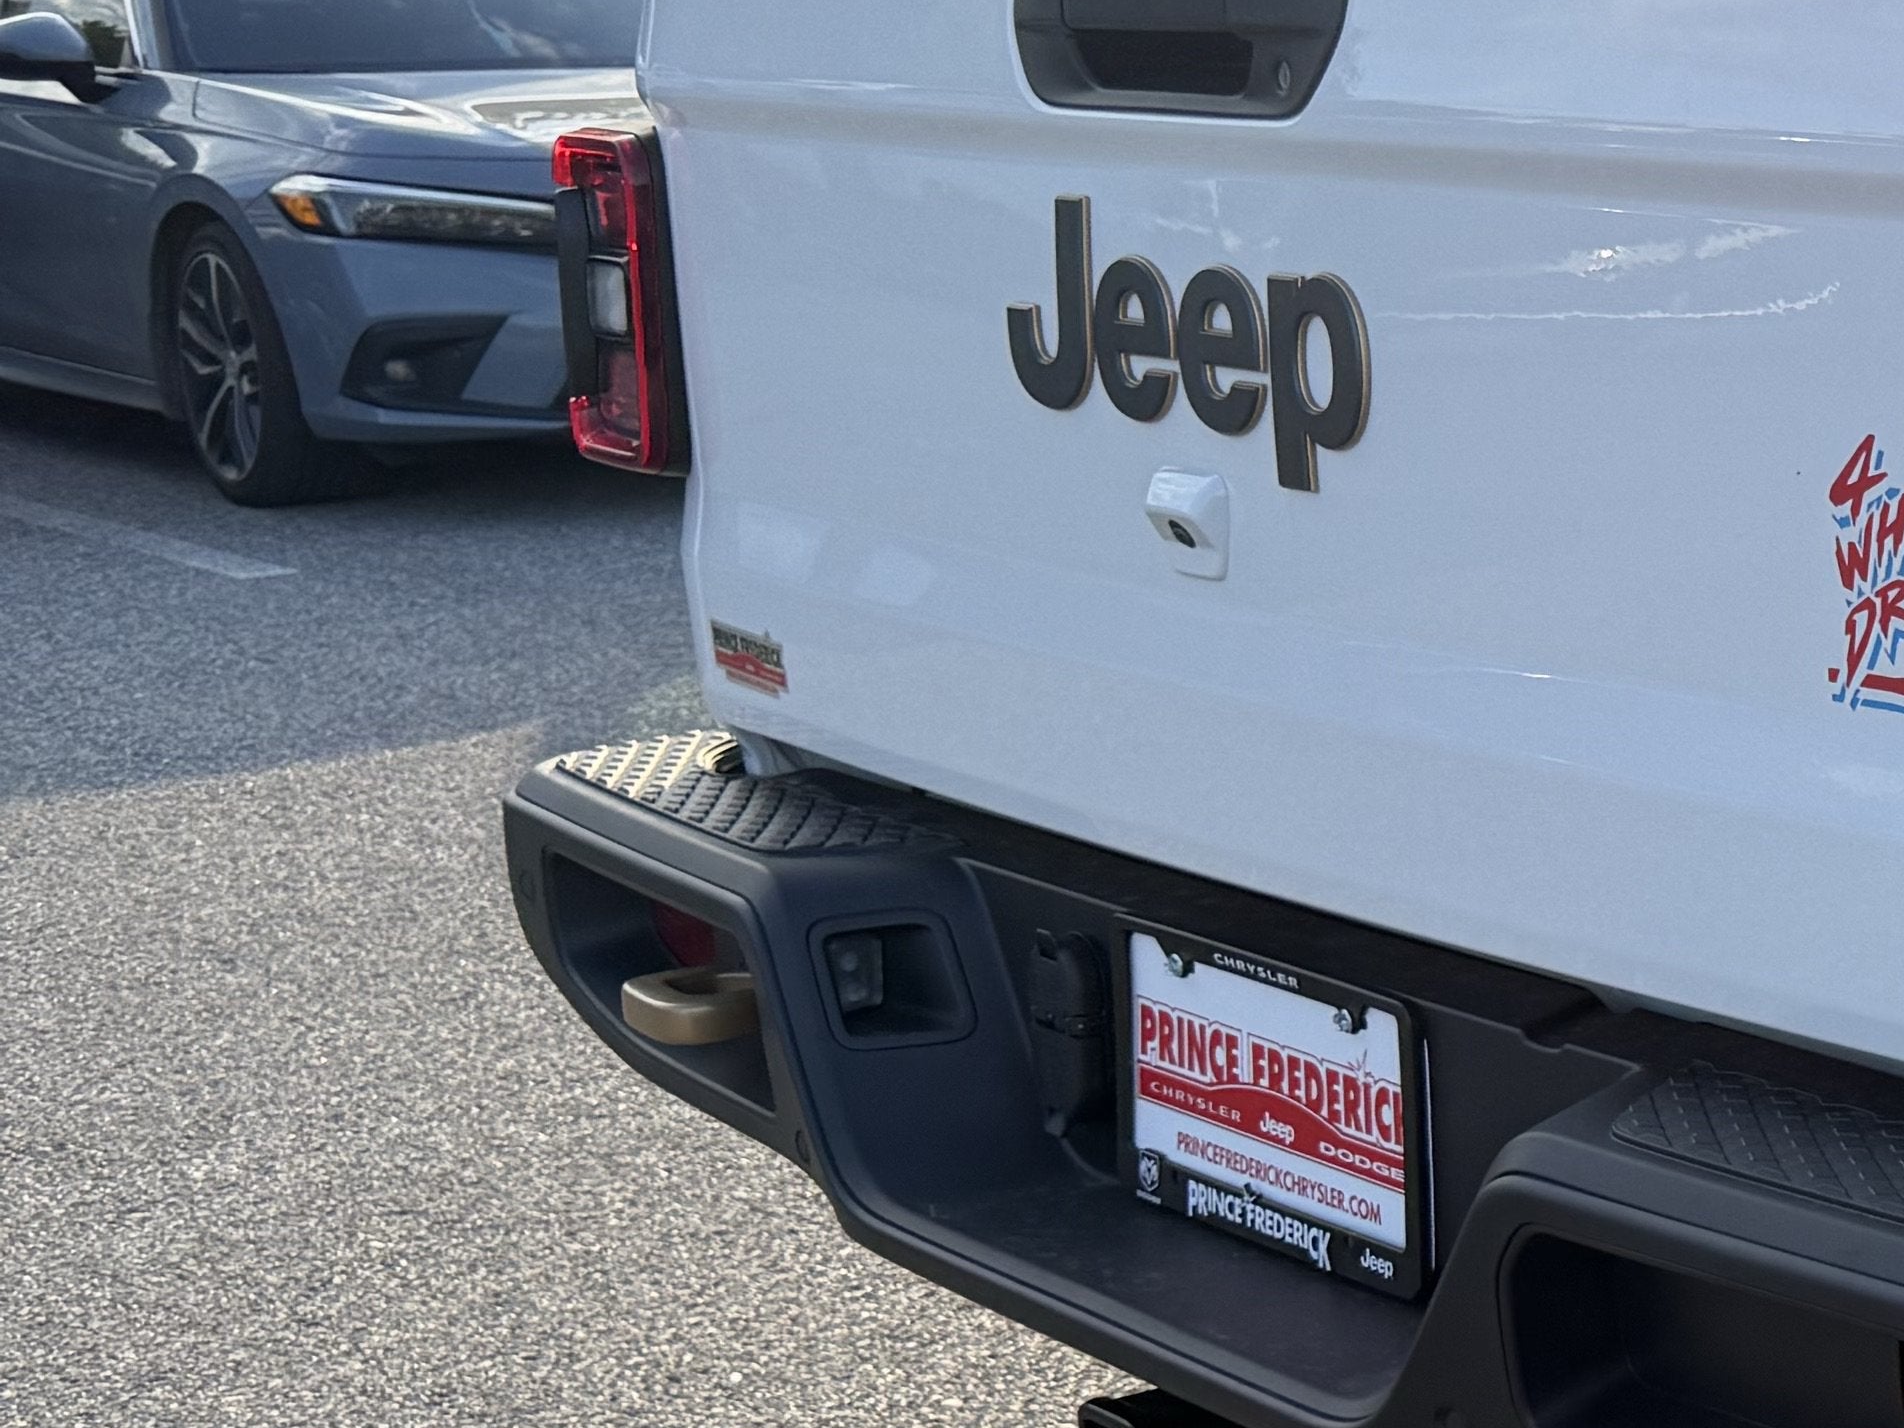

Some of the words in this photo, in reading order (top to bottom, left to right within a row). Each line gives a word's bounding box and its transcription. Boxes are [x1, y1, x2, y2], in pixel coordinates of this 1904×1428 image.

[1006, 194, 1371, 493] Jeep
[1828, 433, 1888, 527] 4
[1213, 952, 1299, 989] CHRYSLER
[1140, 1003, 1241, 1084] PRINCE
[1150, 1081, 1240, 1123] CHRYSLER
[1259, 1111, 1295, 1146] Jeep
[1319, 1140, 1405, 1183] DODGE
[1177, 1131, 1382, 1225] PRINCEFREDERICKCHRYSLER.COM
[1187, 1178, 1243, 1223] PRINCE
[1245, 1198, 1332, 1271] FREDERICK
[1360, 1247, 1395, 1280] Jeep
